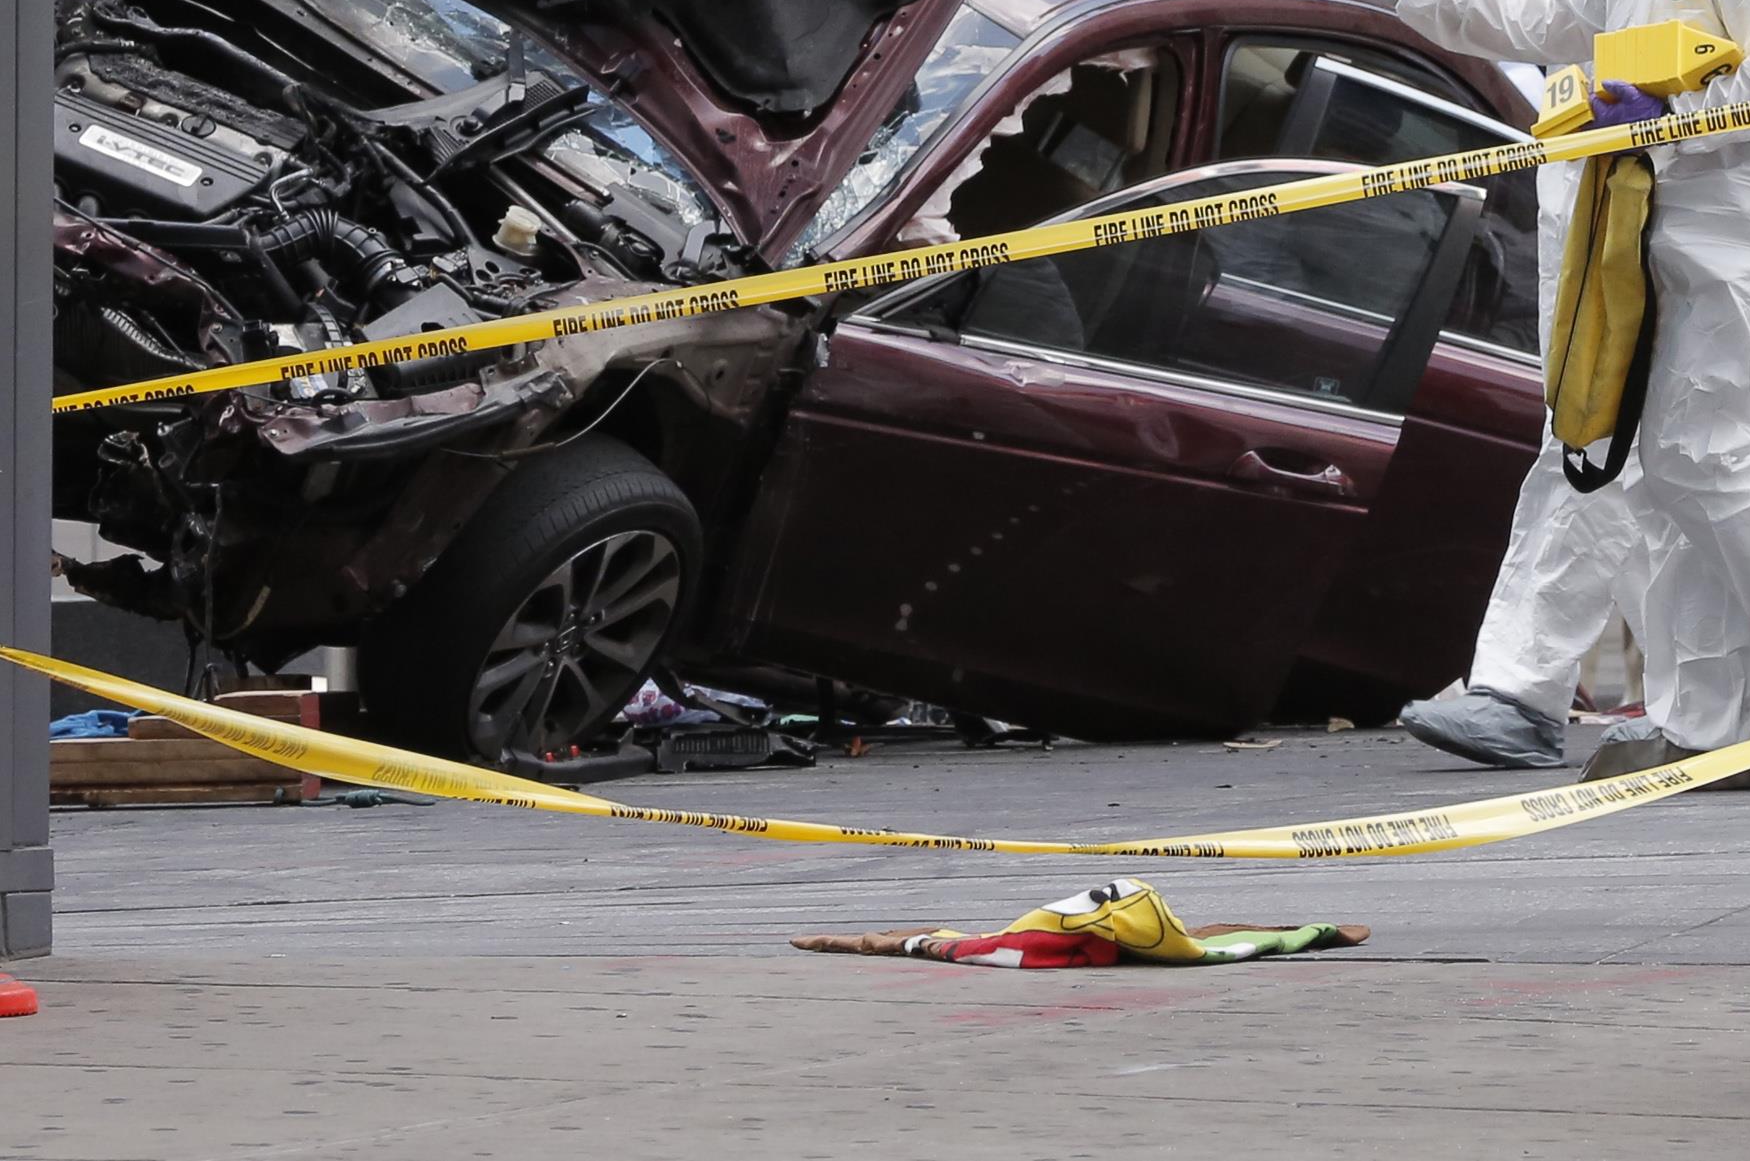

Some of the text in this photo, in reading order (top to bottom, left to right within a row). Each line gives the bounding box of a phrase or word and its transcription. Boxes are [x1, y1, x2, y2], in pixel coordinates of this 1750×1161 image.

[1546, 74, 1574, 109] 19
[1630, 118, 1665, 146] FIRE
[1668, 111, 1702, 140] LINE
[1706, 107, 1727, 133] DO
[1361, 142, 1547, 198] FIRE LINE DO NOT CROSS
[1093, 193, 1279, 246] FIRE LINE DO NOT CROSS
[862, 262, 896, 287] LINE
[900, 258, 922, 280] DO
[925, 252, 954, 275] NOT
[960, 242, 1010, 271] CROSS
[655, 299, 684, 320] NOT
[1520, 766, 1693, 822] FIRE LINE DO NOT CROSS
[1291, 814, 1459, 858] FIRE LINE DO NOT CROSS
